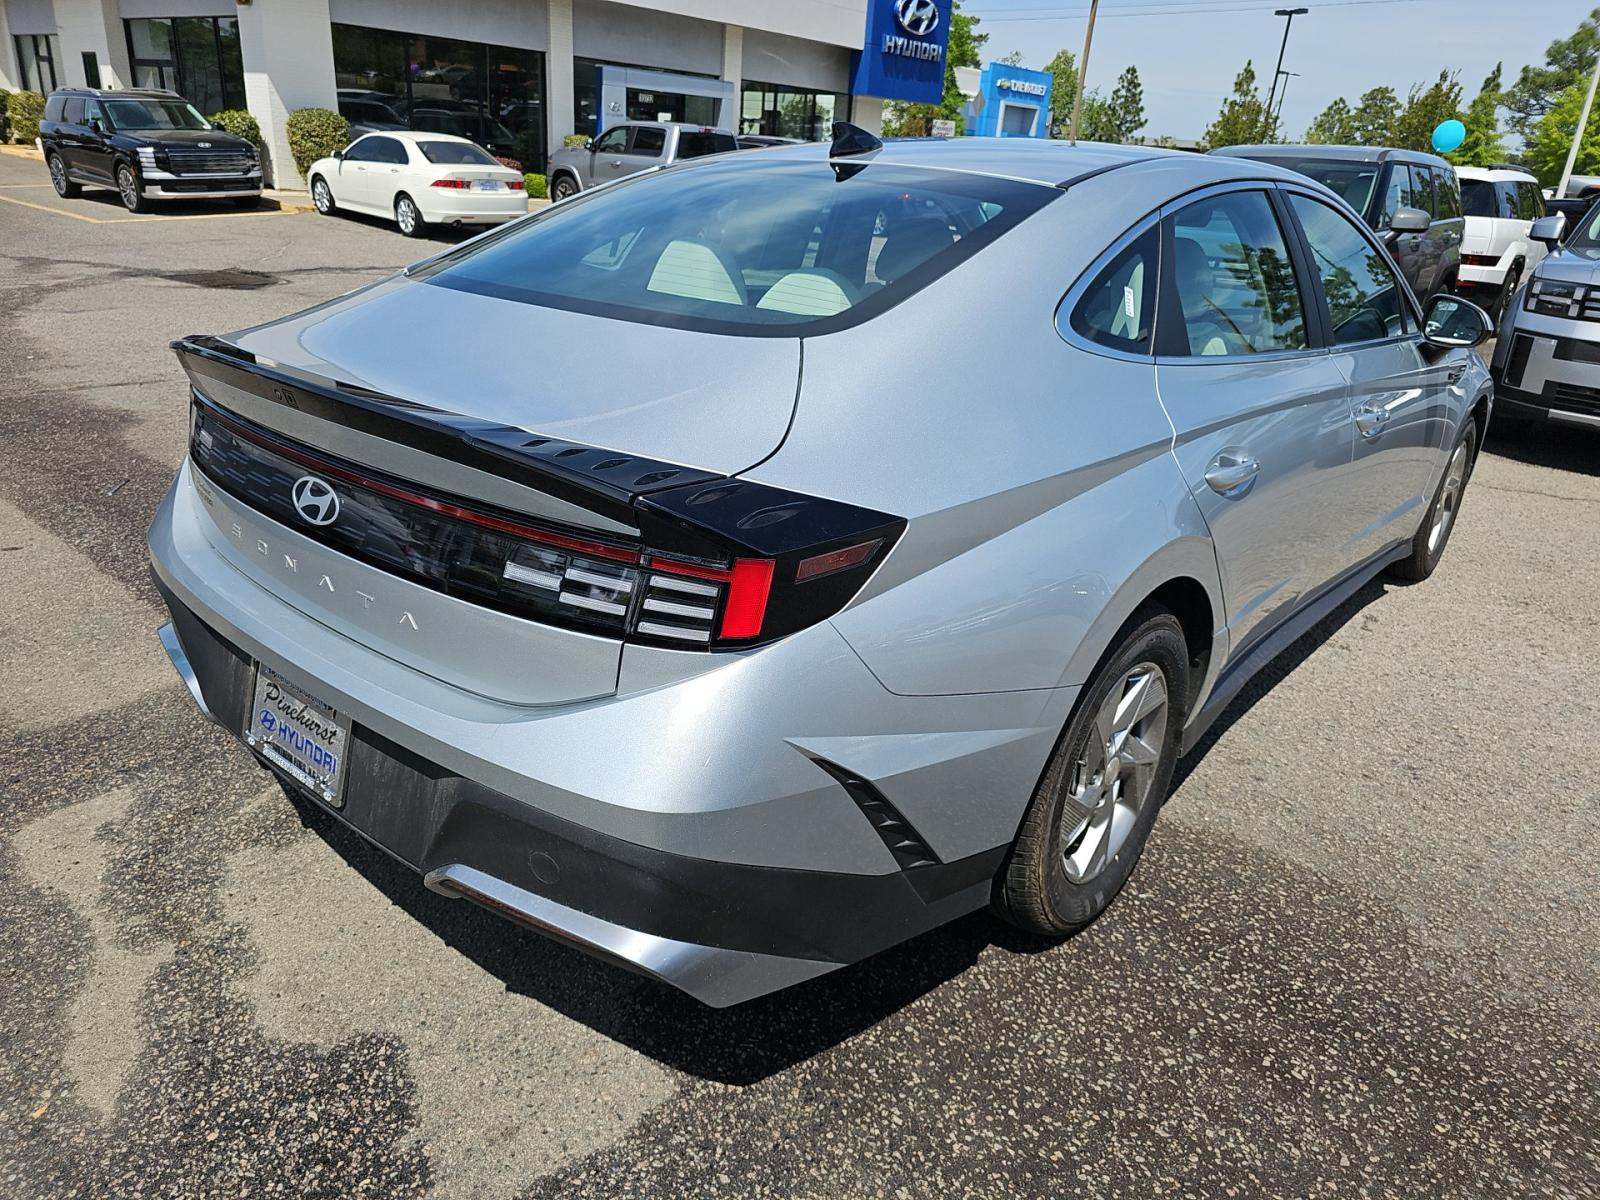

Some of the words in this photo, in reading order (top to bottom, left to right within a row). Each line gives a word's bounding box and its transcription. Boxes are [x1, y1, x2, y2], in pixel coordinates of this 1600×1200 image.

[882, 34, 943, 62] HYUNDAI
[231, 523, 419, 631] SONATA
[264, 682, 338, 745] Pinehurst
[278, 720, 337, 775] HYUNDAI
